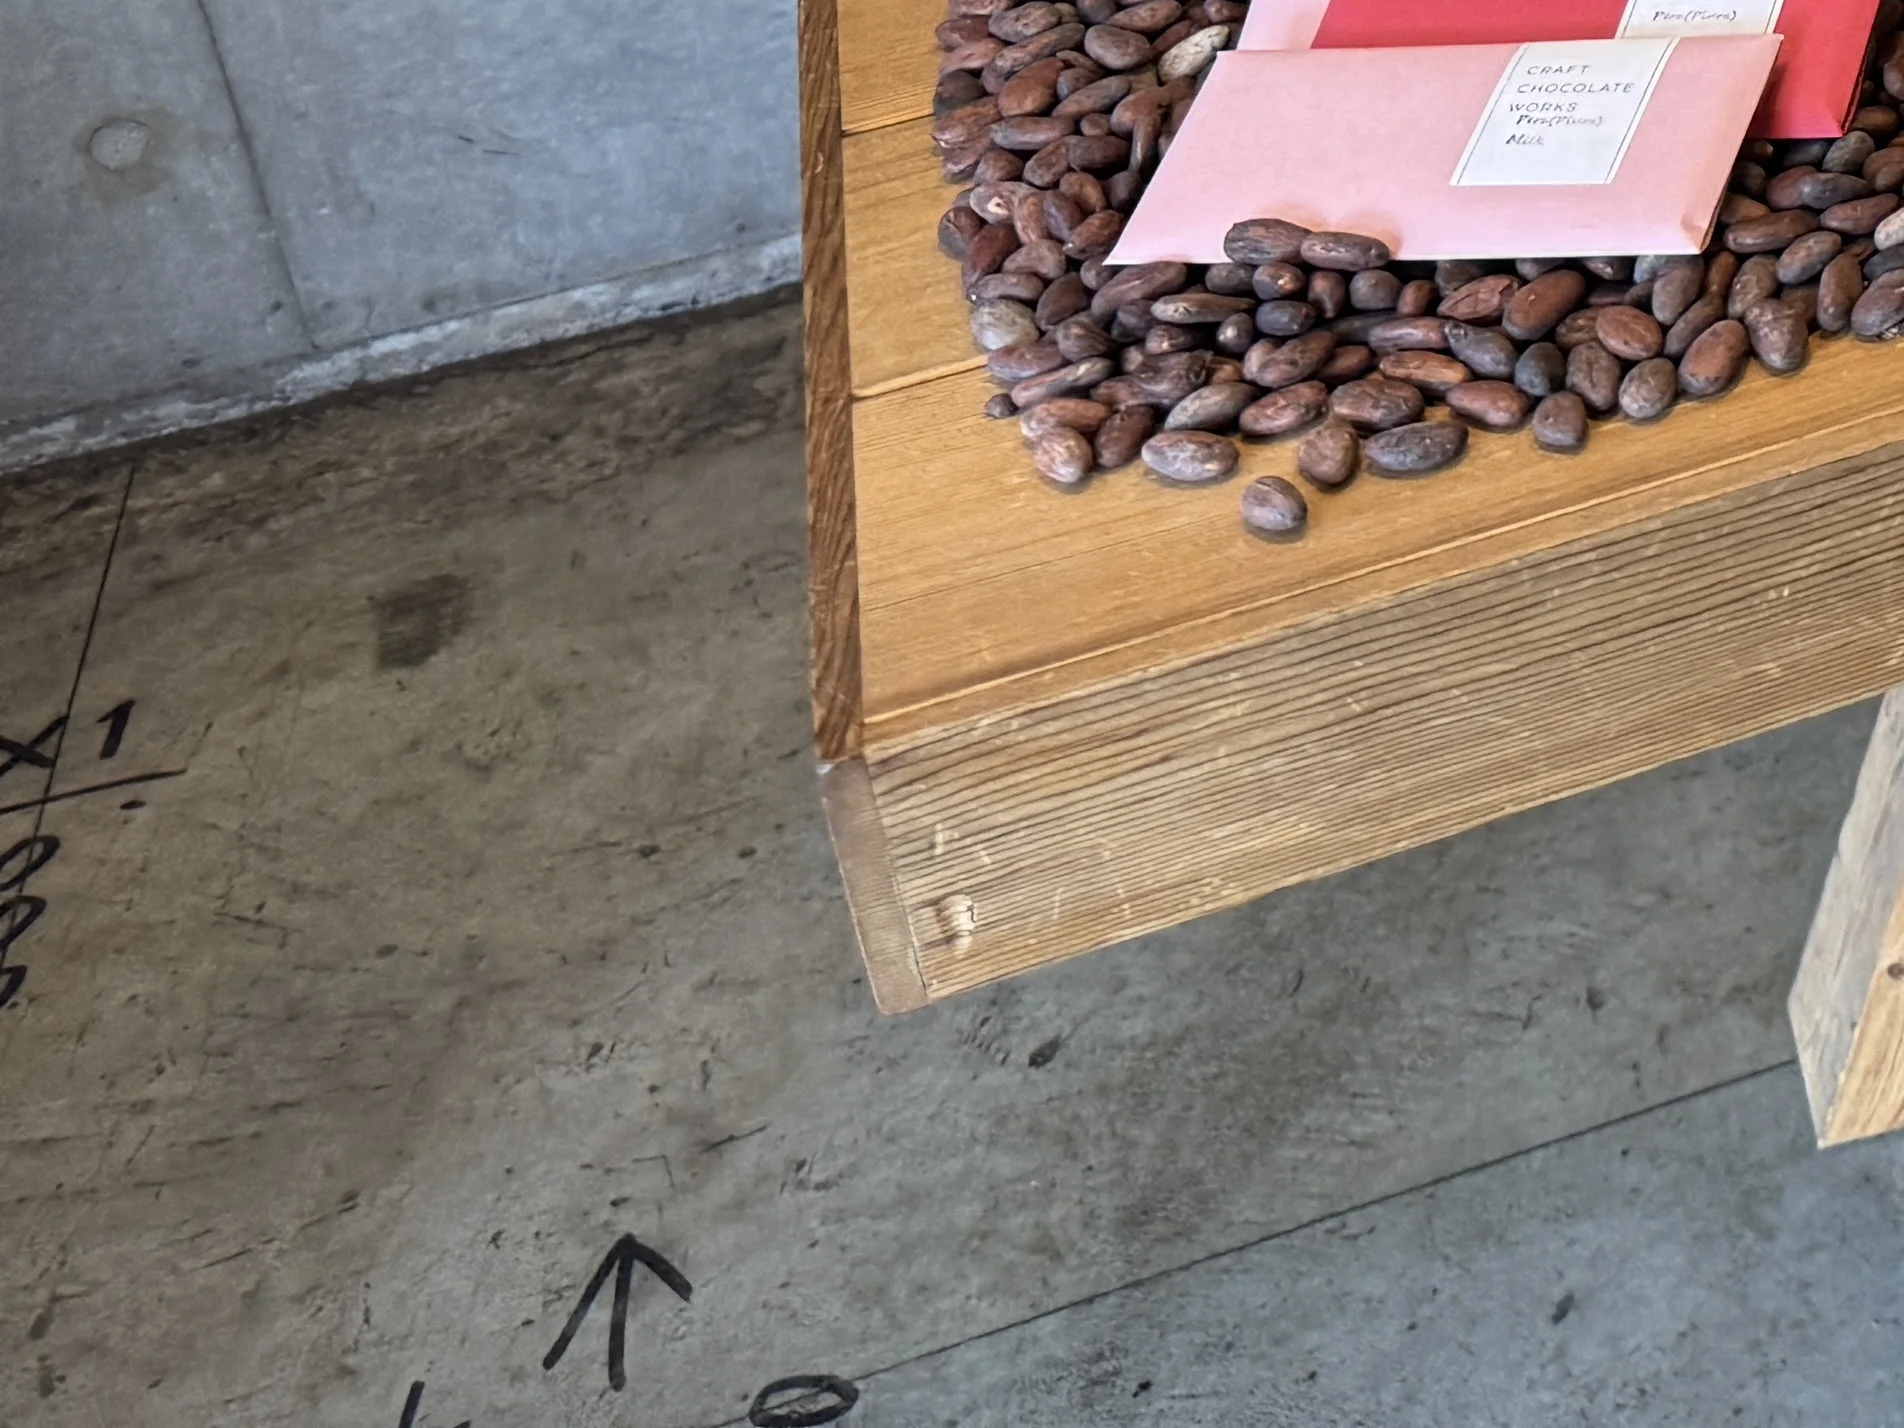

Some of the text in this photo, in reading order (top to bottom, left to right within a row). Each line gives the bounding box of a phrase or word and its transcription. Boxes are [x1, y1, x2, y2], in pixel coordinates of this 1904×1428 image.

[1527, 65, 1591, 76] CRAFT
[1516, 82, 1635, 94] CHOCOLATE
[1509, 102, 1578, 113] WORKS
